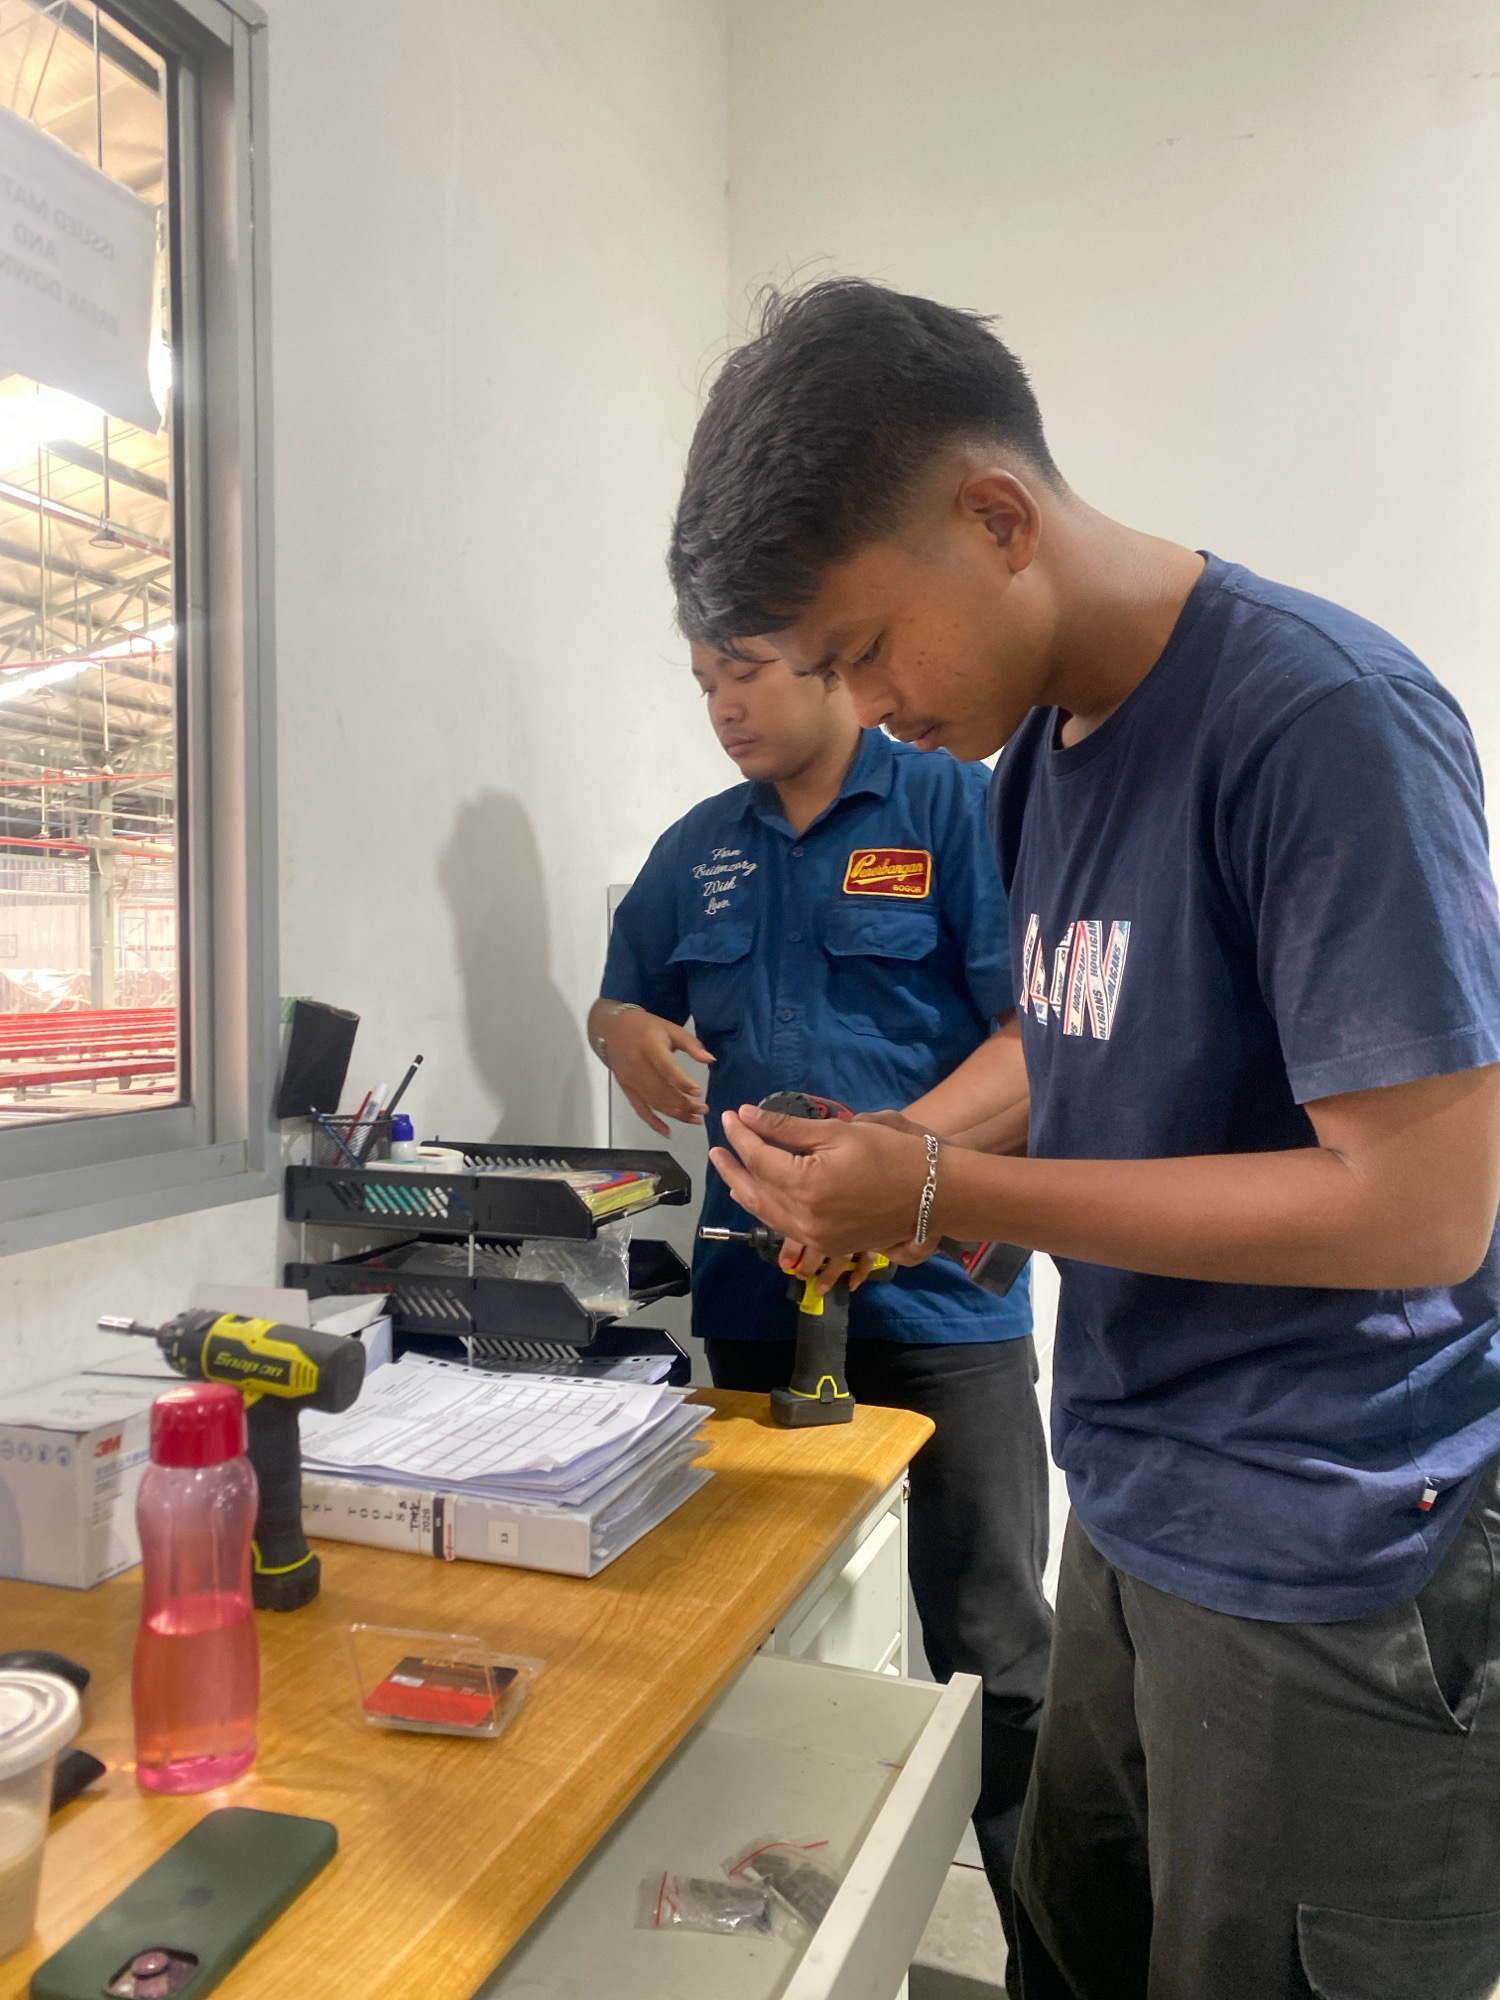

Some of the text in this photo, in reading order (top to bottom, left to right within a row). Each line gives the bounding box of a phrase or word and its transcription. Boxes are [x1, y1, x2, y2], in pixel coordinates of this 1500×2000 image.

[850, 854, 925, 882] Penerbangan
[703, 875, 737, 897] With
[893, 884, 922, 893] BOGOR
[94, 1434, 122, 1458] 3M
